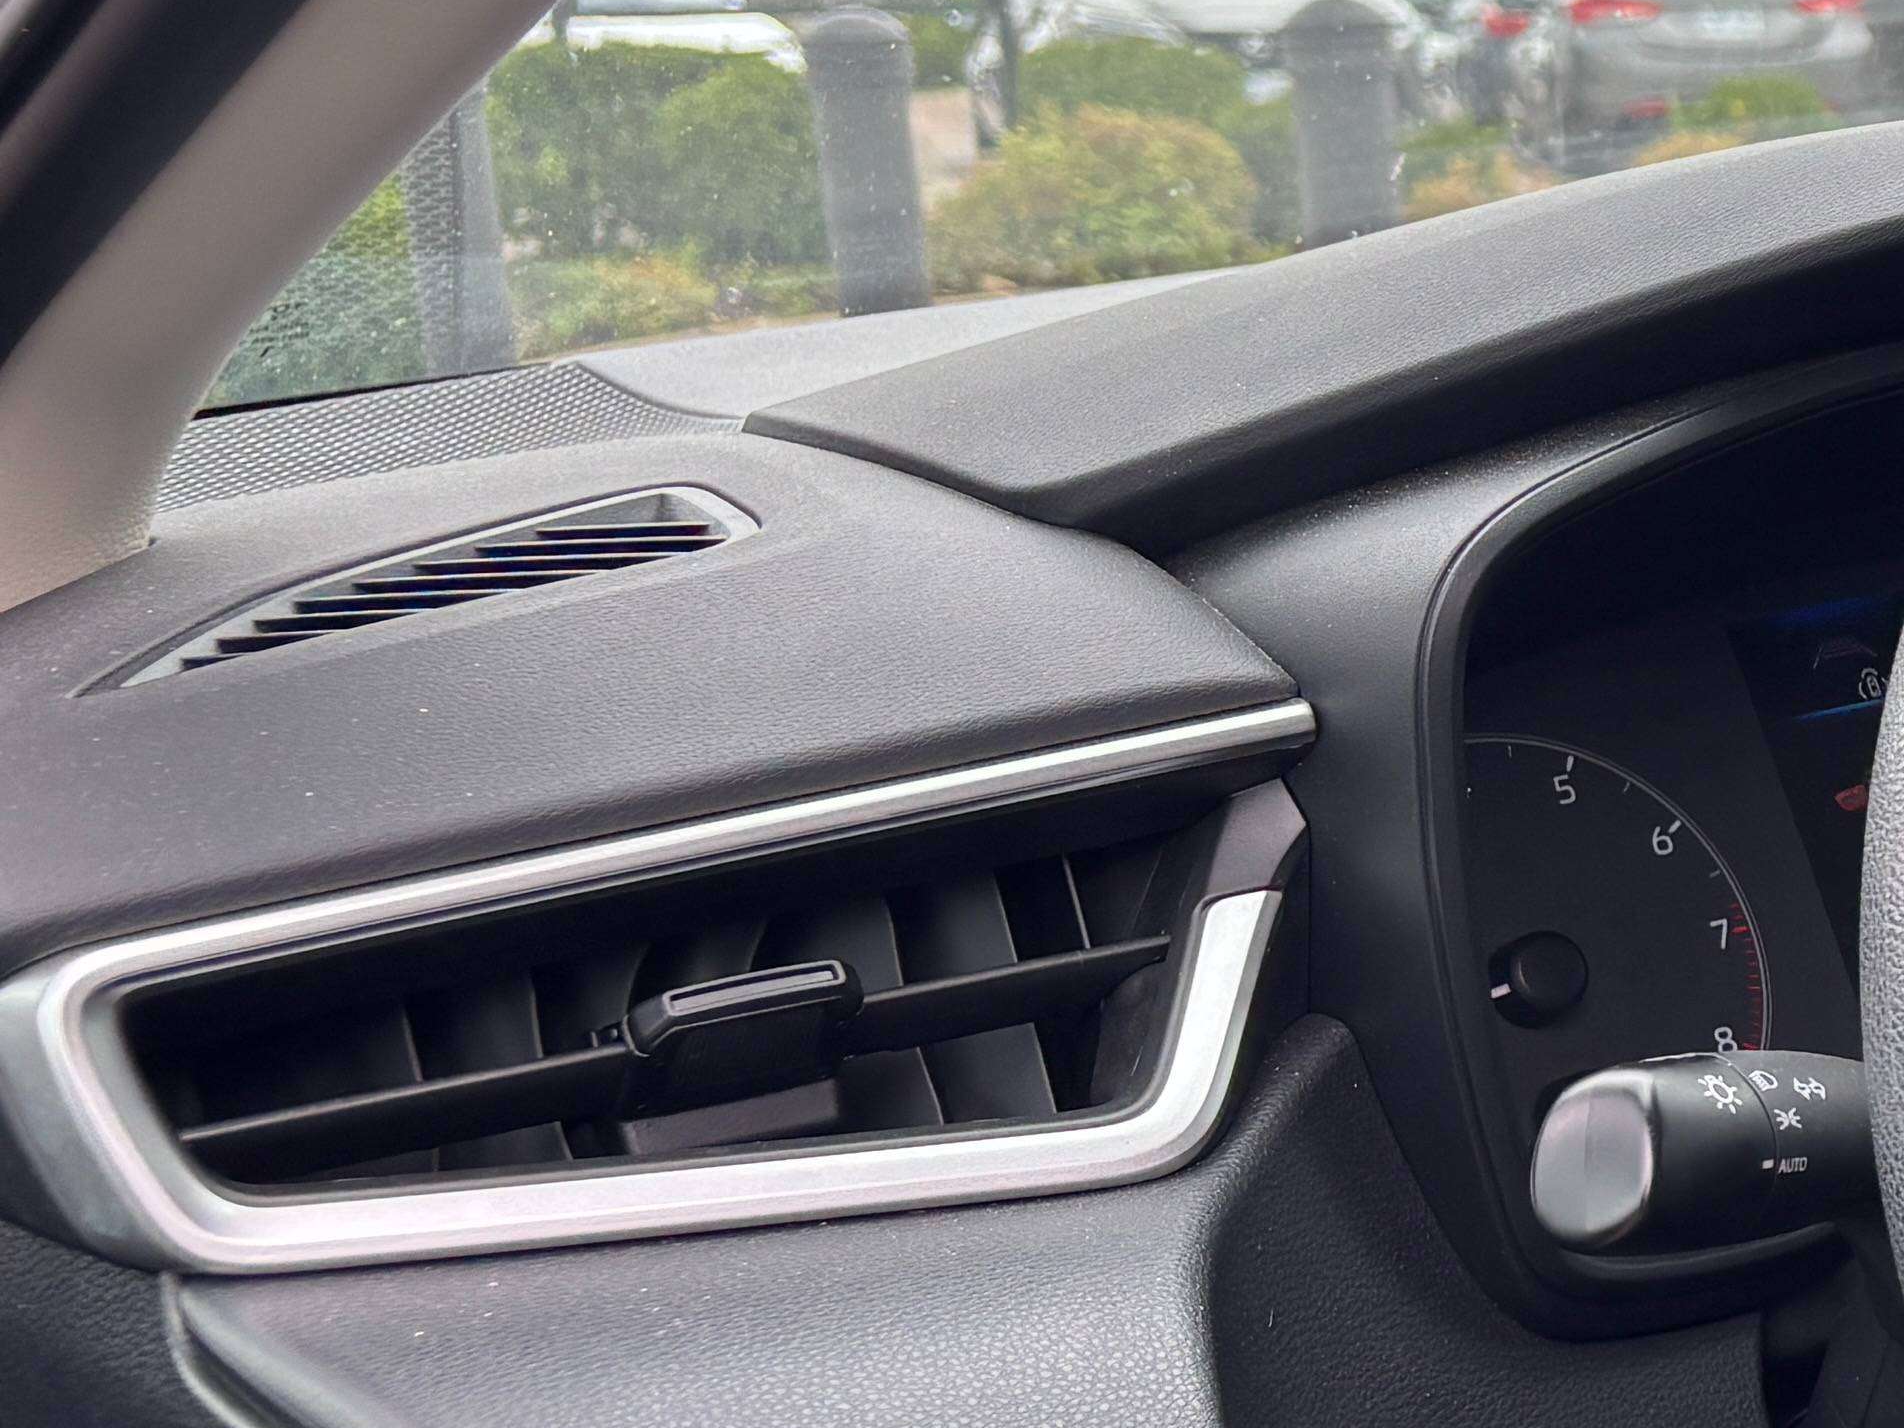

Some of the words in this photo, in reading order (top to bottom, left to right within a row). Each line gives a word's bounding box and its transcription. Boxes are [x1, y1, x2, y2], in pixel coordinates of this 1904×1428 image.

[1553, 774, 1576, 805] 5
[1652, 826, 1674, 855] 6
[1710, 918, 1728, 950] 7
[1713, 1026, 1738, 1053] 8
[1778, 1157, 1808, 1174] AUTO
